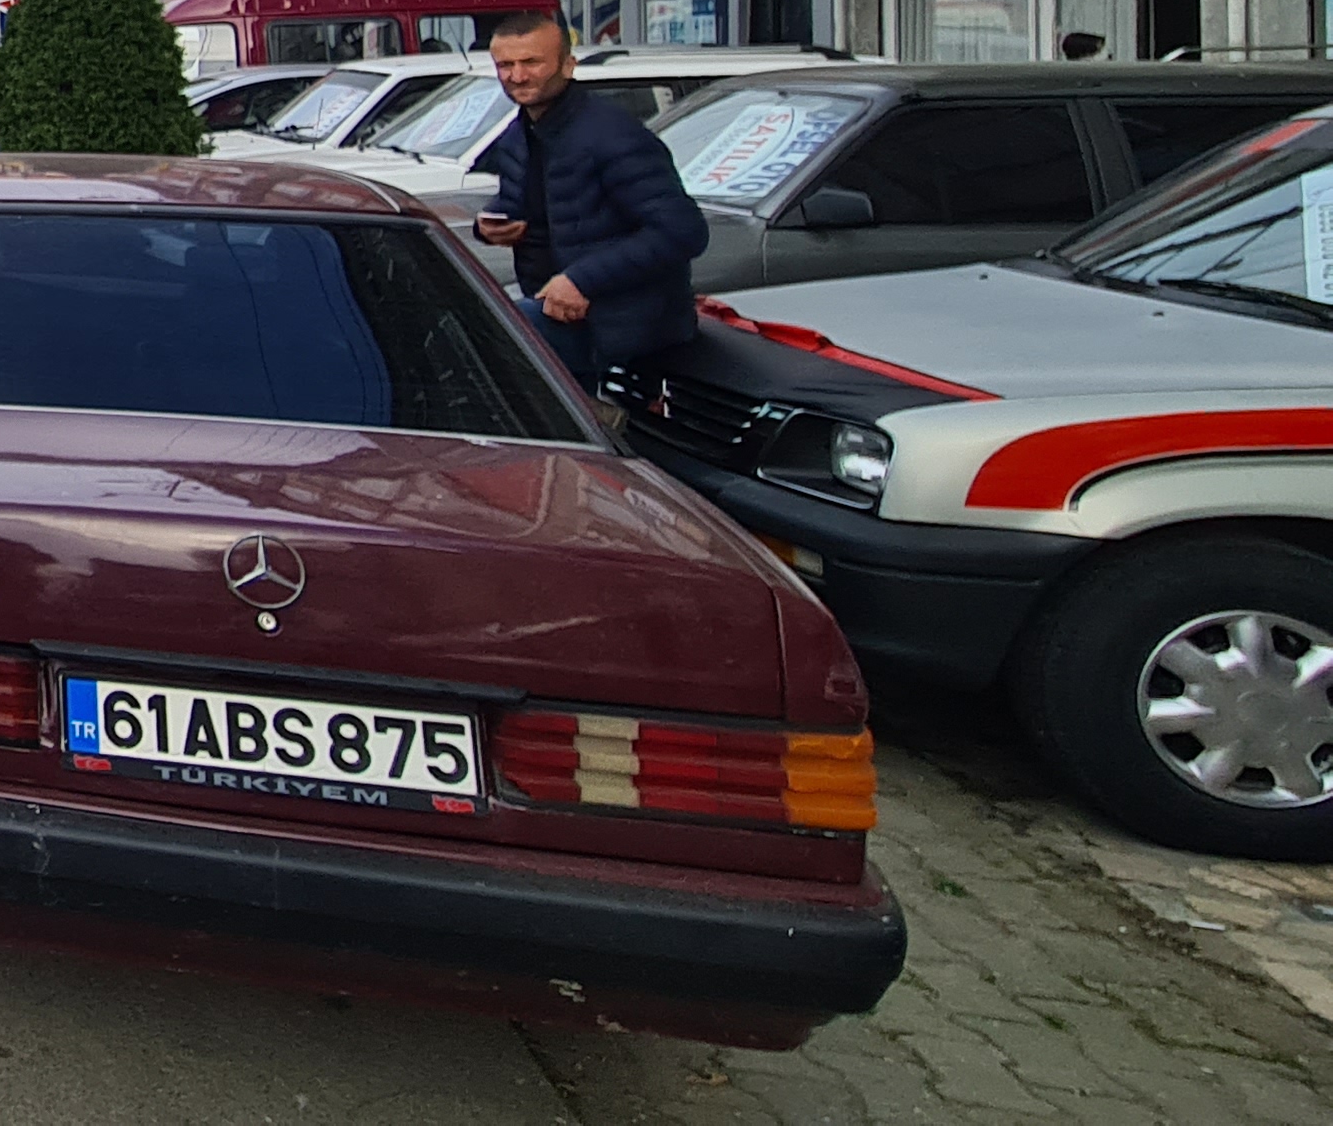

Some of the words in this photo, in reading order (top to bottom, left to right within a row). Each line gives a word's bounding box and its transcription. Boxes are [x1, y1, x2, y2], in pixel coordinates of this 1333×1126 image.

[699, 113, 790, 184] SATILIK
[71, 720, 96, 739] TR
[153, 764, 388, 806] TÜRKİYEM
